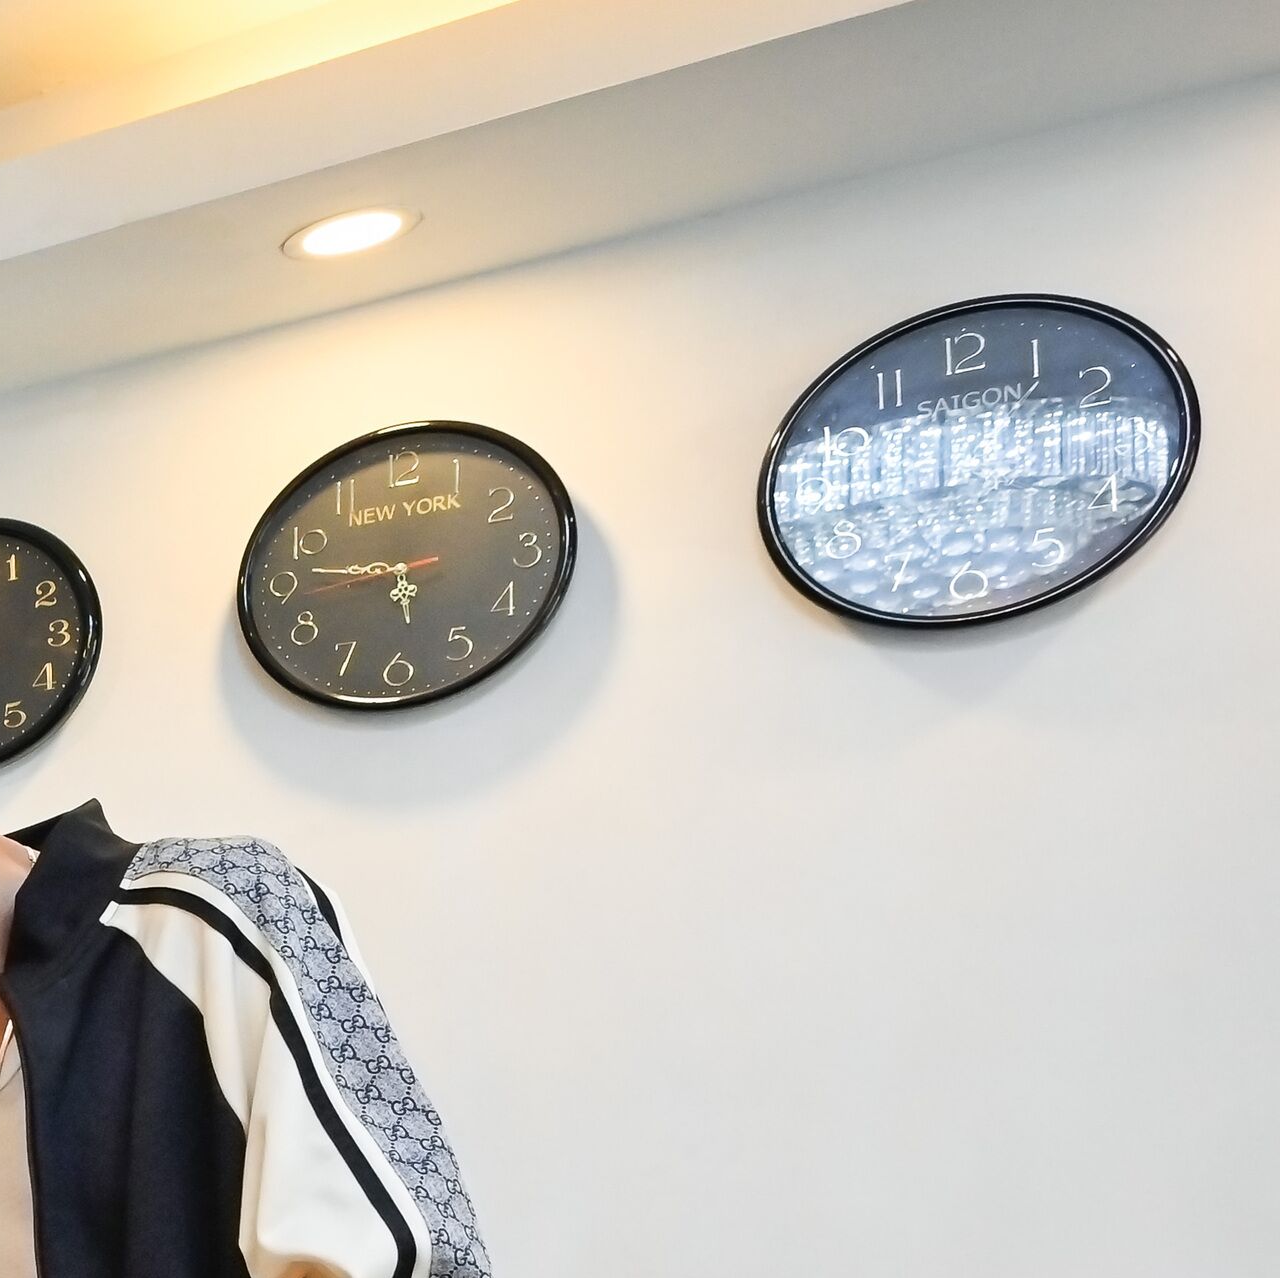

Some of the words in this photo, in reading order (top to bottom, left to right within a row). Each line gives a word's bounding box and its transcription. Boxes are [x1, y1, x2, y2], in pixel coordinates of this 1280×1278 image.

[944, 332, 986, 376] 12
[1031, 338, 1040, 378] 1
[876, 369, 904, 410] 11
[917, 382, 1022, 422] SAIGON
[1078, 365, 1113, 409] 2
[822, 426, 870, 464] 10
[389, 451, 420, 488] 12
[452, 458, 460, 493] 1
[336, 480, 355, 517] 11
[348, 506, 395, 527] NEW
[402, 493, 461, 518] YORK
[488, 487, 515, 523] 2
[1087, 474, 1119, 512] 4
[293, 526, 328, 560] 10
[512, 532, 543, 568] 3
[825, 520, 862, 560] 8
[1031, 527, 1065, 567] 5
[6, 554, 19, 582] 1
[883, 552, 914, 593] 7
[948, 561, 989, 600] 6
[34, 580, 58, 609] 2
[269, 571, 298, 605] 9
[490, 581, 516, 616] 4
[47, 619, 72, 647] 3
[290, 611, 319, 646] 8
[446, 626, 474, 662] 5
[32, 662, 57, 691] 4
[335, 641, 358, 677] 7
[382, 652, 415, 687] 6
[3, 701, 26, 728] 5
